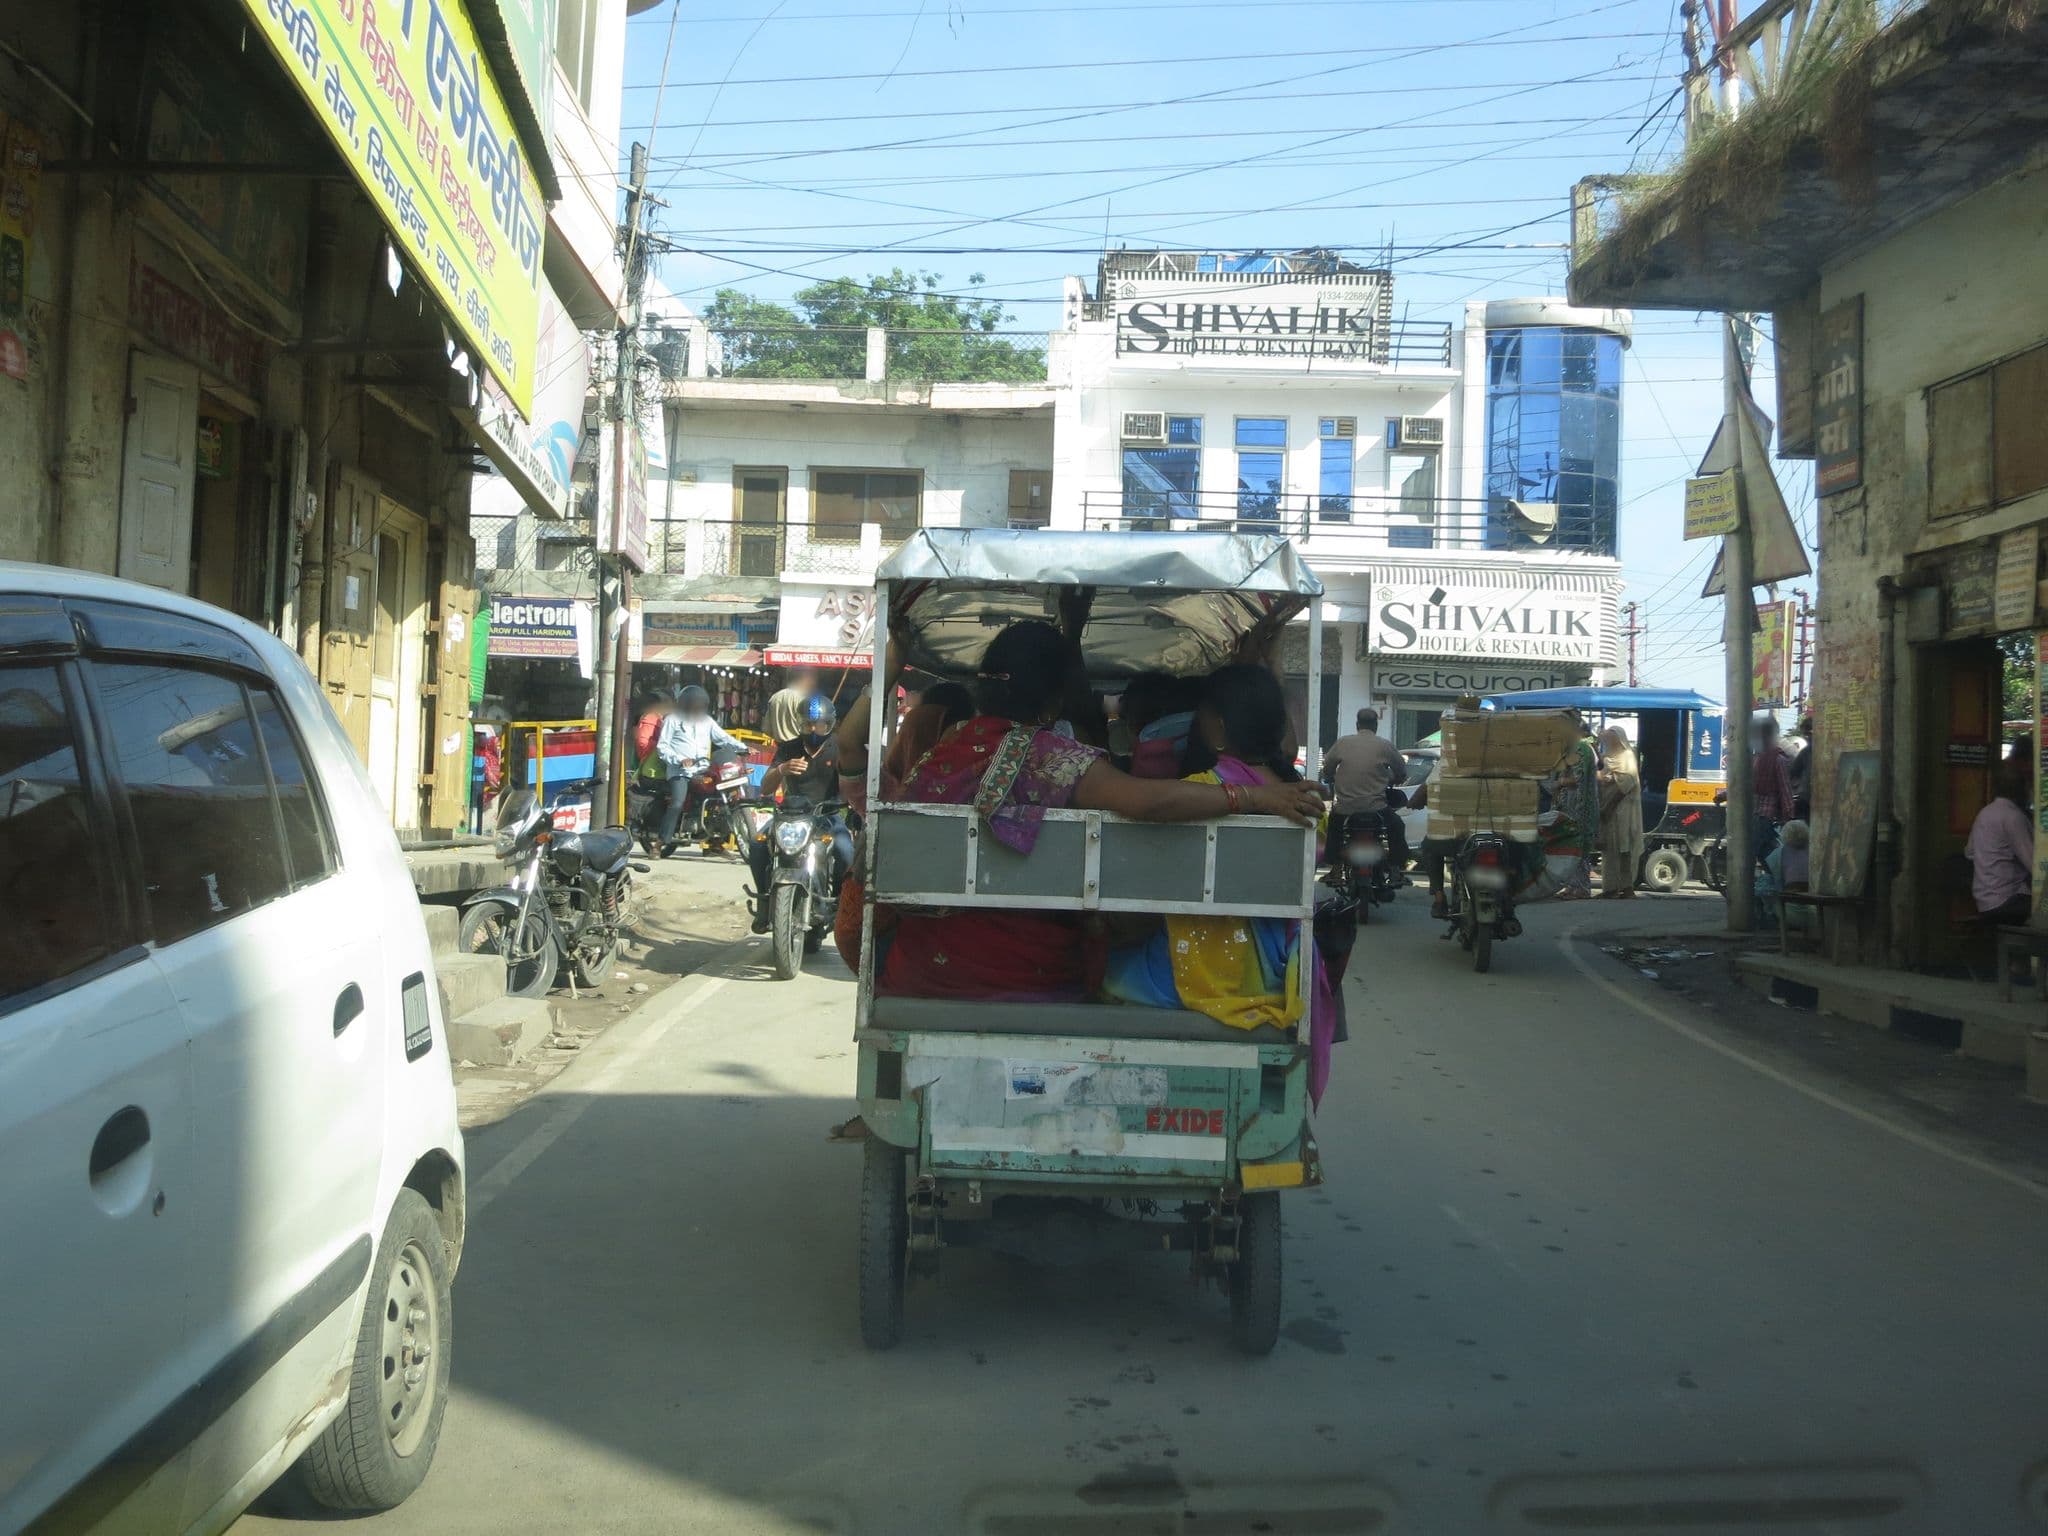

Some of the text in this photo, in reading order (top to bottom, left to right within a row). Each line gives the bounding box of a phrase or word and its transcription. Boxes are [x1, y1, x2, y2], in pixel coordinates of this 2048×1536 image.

[1127, 301, 1370, 353] SHIVALIK
[1174, 338, 1371, 362] HOTEL & RESTAURANT
[1378, 602, 1593, 649] SHIVALIK
[770, 653, 793, 662] BRIDAL
[821, 654, 843, 664] FANCY
[1419, 635, 1593, 658] HOTEL & RESTAURANT
[1377, 671, 1563, 691] restaurant
[1146, 1107, 1225, 1135] EXIDE
